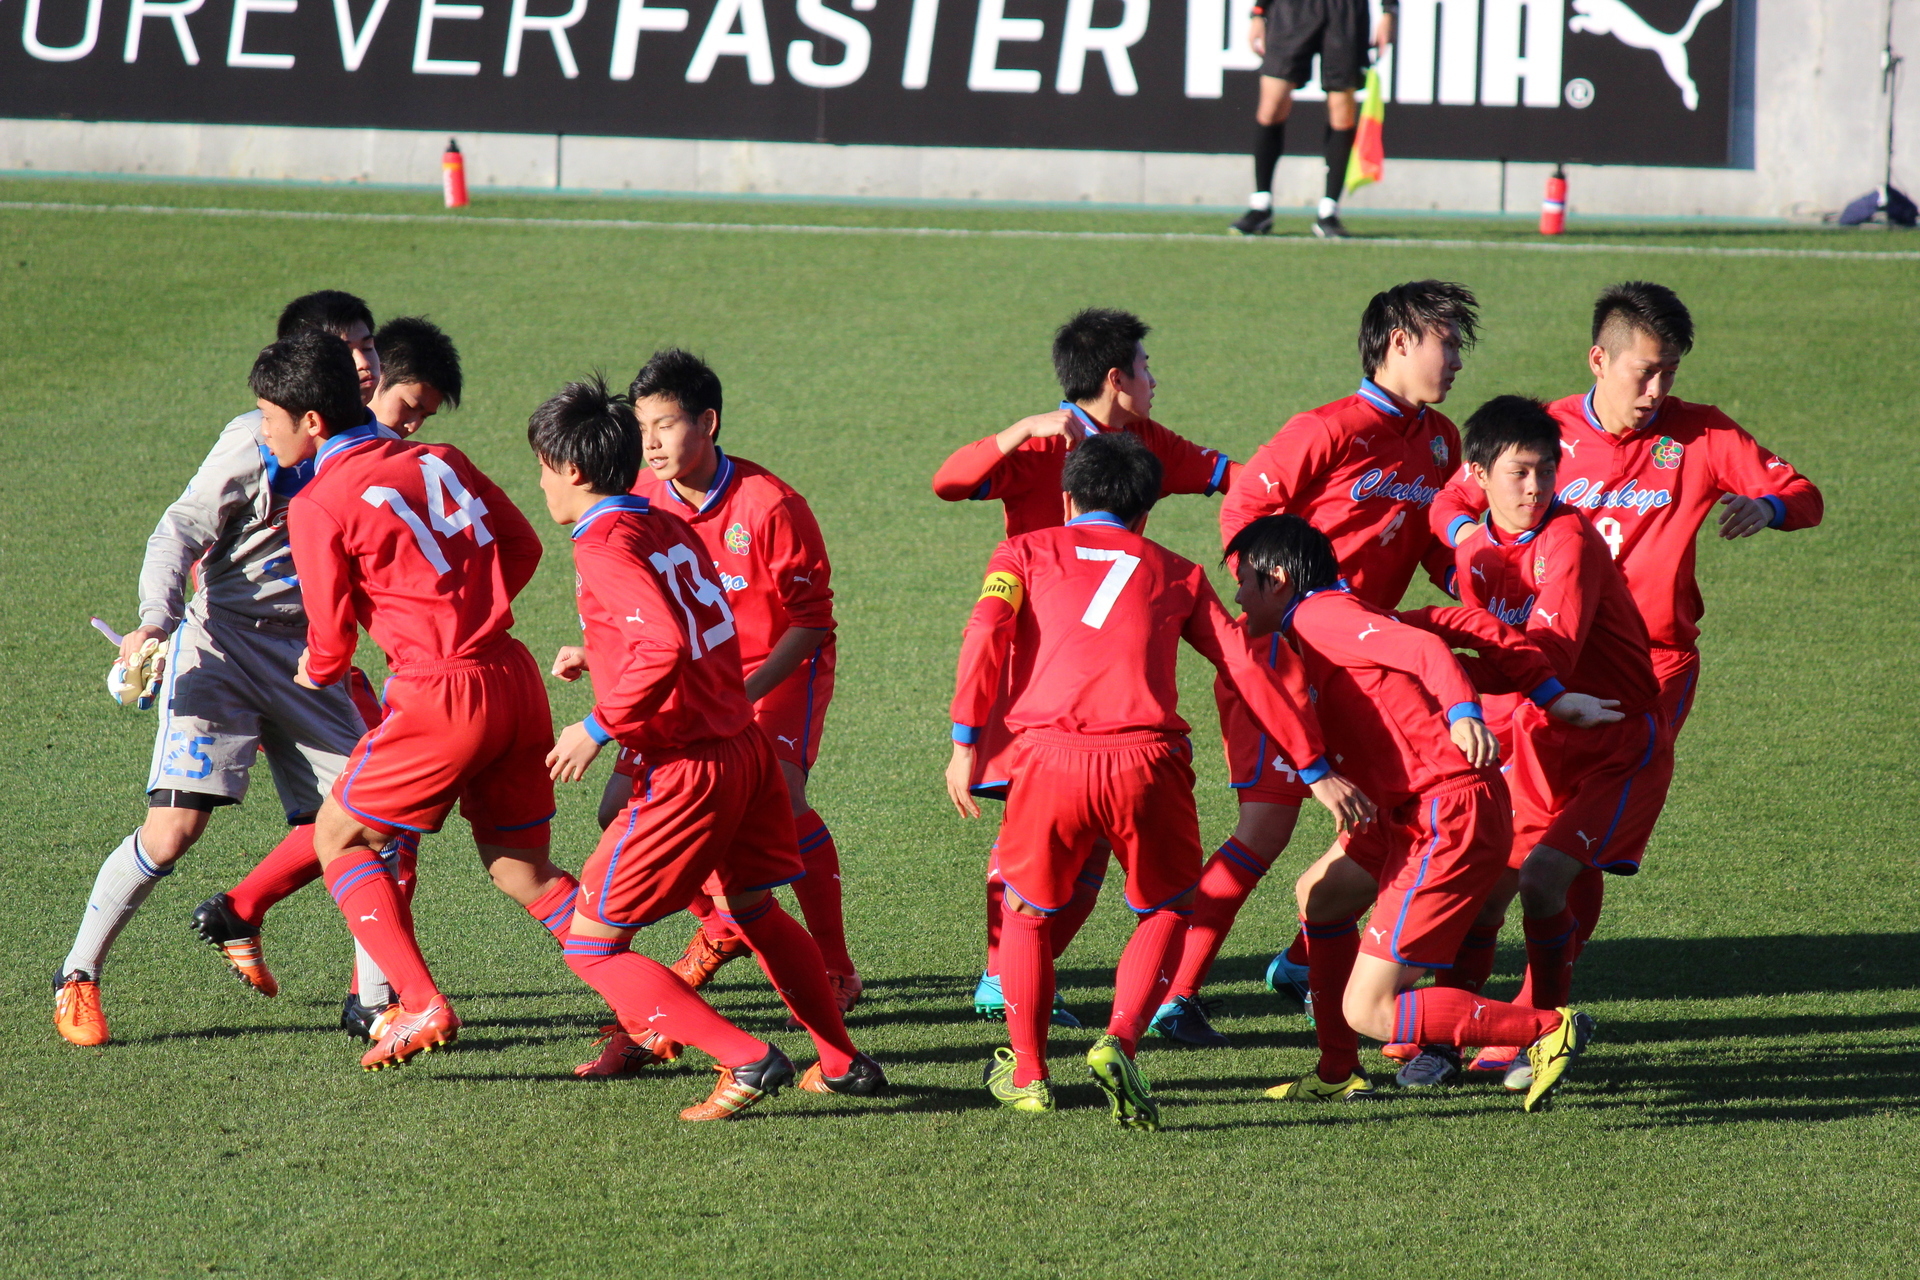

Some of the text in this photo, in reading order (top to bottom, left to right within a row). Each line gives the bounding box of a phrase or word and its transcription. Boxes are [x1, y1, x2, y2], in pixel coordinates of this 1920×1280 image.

[360, 453, 494, 577] 14
[1379, 511, 1407, 547] 4
[1558, 477, 1673, 516] Chukyo
[648, 542, 735, 661] 13
[1075, 545, 1142, 630] 7
[163, 731, 216, 779] 25
